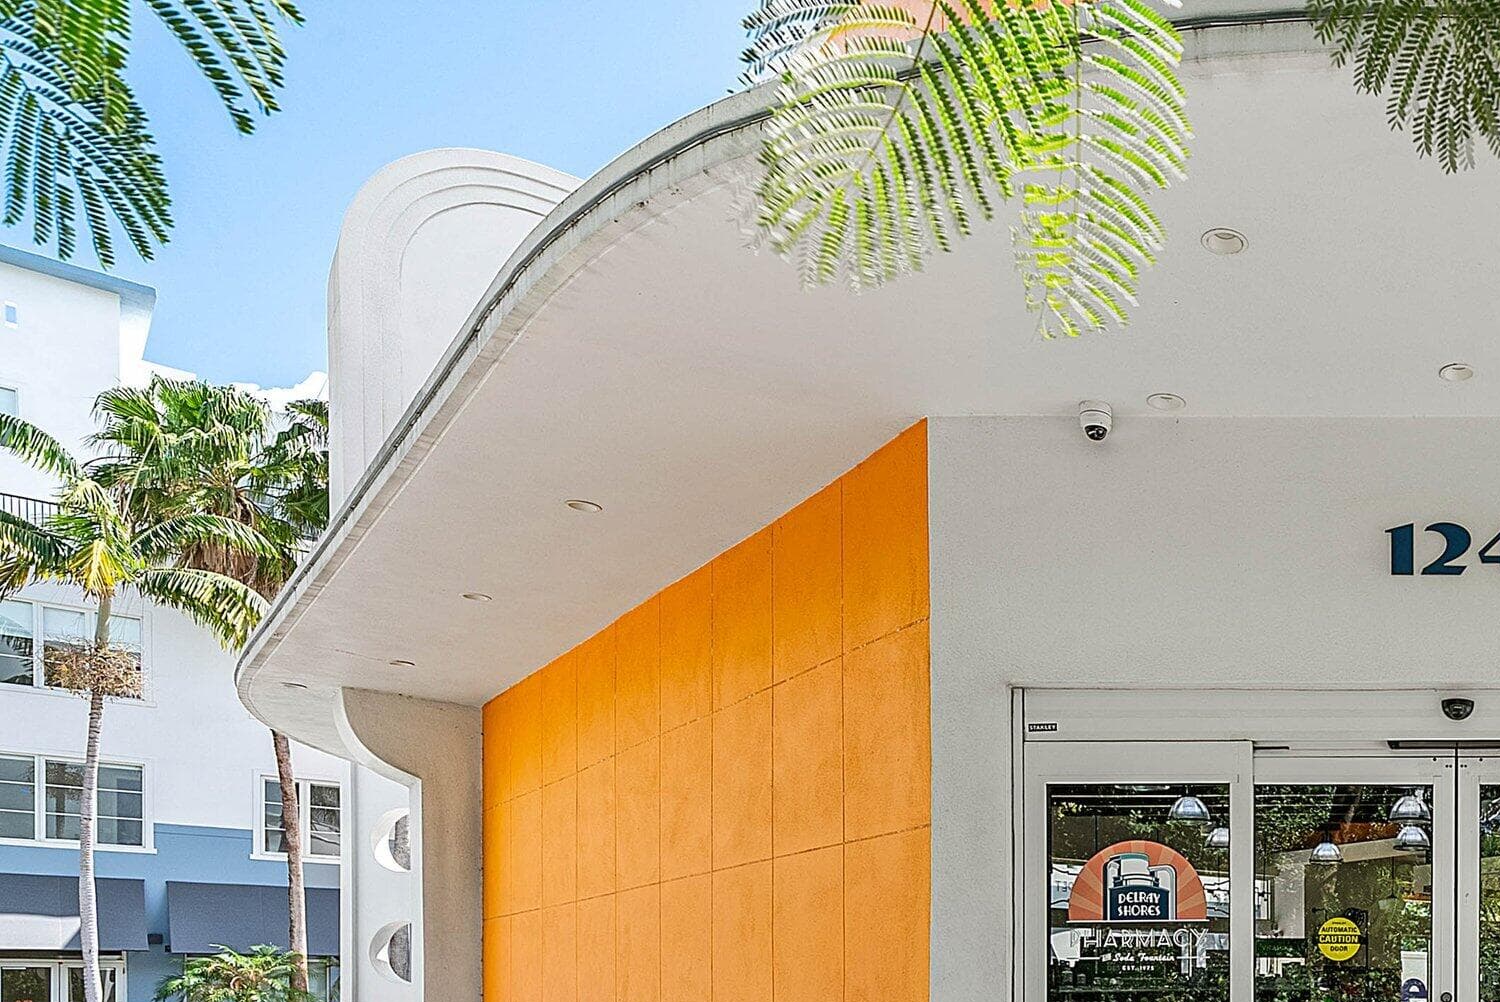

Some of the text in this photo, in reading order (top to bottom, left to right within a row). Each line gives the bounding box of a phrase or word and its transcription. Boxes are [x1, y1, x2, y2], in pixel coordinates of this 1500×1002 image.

[1118, 891, 1160, 904] DELRAY
[1118, 905, 1160, 917] SHORES
[1070, 928, 1209, 948] PHARMACY
[1319, 935, 1359, 943] CAUTION
